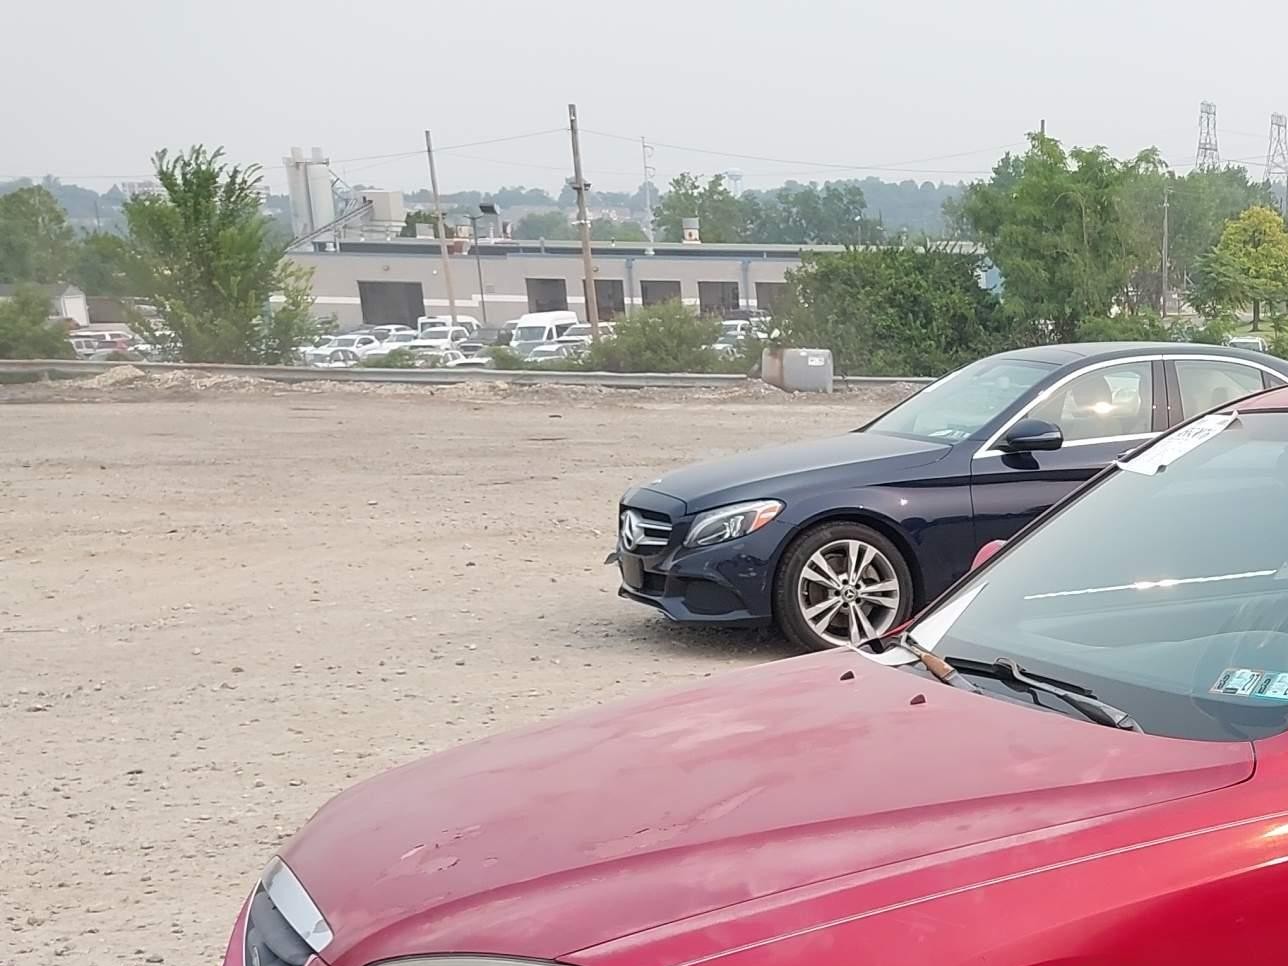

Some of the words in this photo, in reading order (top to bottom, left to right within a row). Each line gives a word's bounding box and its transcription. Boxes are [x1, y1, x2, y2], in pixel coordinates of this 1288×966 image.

[1217, 674, 1230, 690] 3
[1243, 672, 1261, 691] 27
[1259, 678, 1271, 694] 3
